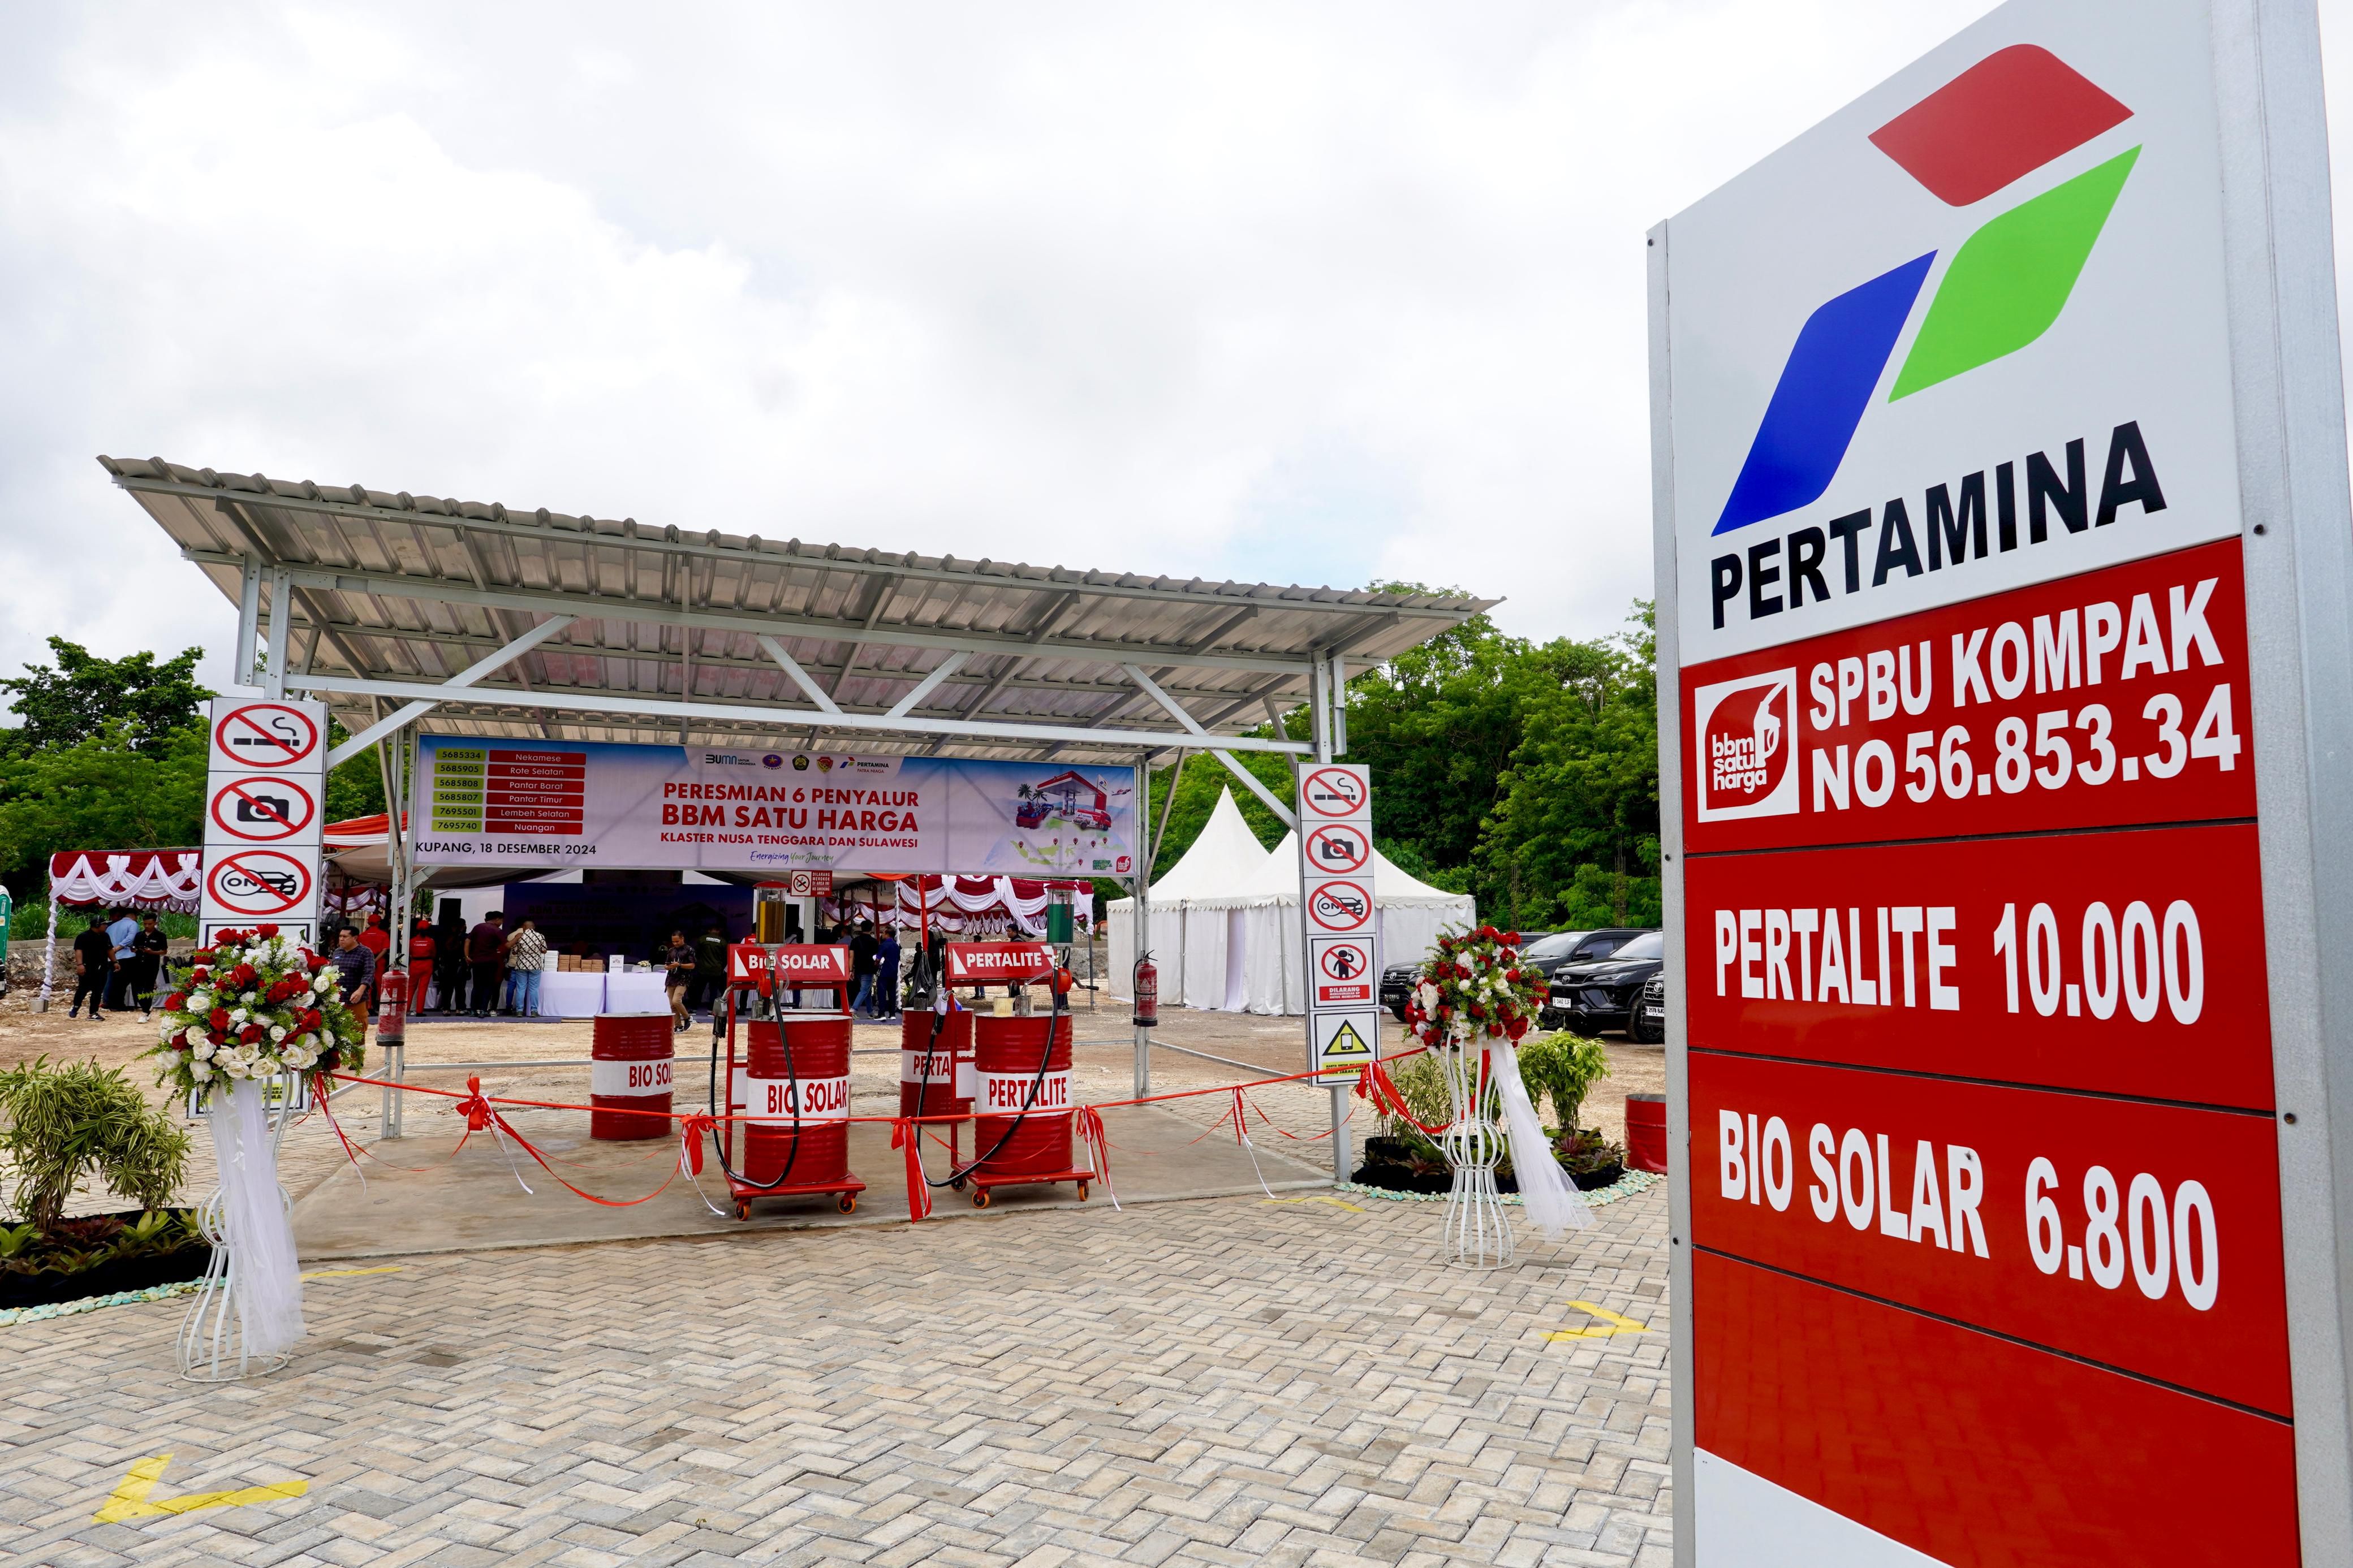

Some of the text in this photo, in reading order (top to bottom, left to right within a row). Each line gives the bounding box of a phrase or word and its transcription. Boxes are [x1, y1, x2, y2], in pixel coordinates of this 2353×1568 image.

[1711, 420, 2167, 630] PERTAMINA
[1810, 577, 2224, 731] SPBU KOMPAK
[442, 751, 561, 762] 5685334 Nekamese
[1712, 733, 1754, 758] bbm
[440, 764, 479, 773] 5685905
[1713, 754, 1755, 774] satu
[1713, 769, 1767, 793] harga
[664, 783, 919, 806] PERESMIAN 6 PENYALUR
[515, 824, 555, 833] Nuangan
[662, 804, 918, 832] BBM SATU HARGA
[415, 843, 597, 854] KUPANG, 18 DESEMBER 2024
[661, 832, 918, 848] KLASTER NUSA TENGGARA DAN SULAWESI
[750, 850, 834, 864] Energizing Your Journey
[227, 878, 257, 887] ON
[781, 954, 830, 969] SOLAR
[966, 952, 1042, 967] PERTALITE
[1716, 900, 2204, 1025] PERTALITE 10.000
[630, 1063, 673, 1087] BIO SOL
[768, 1079, 847, 1114] BIO SOLAR
[989, 1077, 1067, 1107] PERTALITE
[1720, 1109, 2218, 1311] BIO SOLAR 6.800
